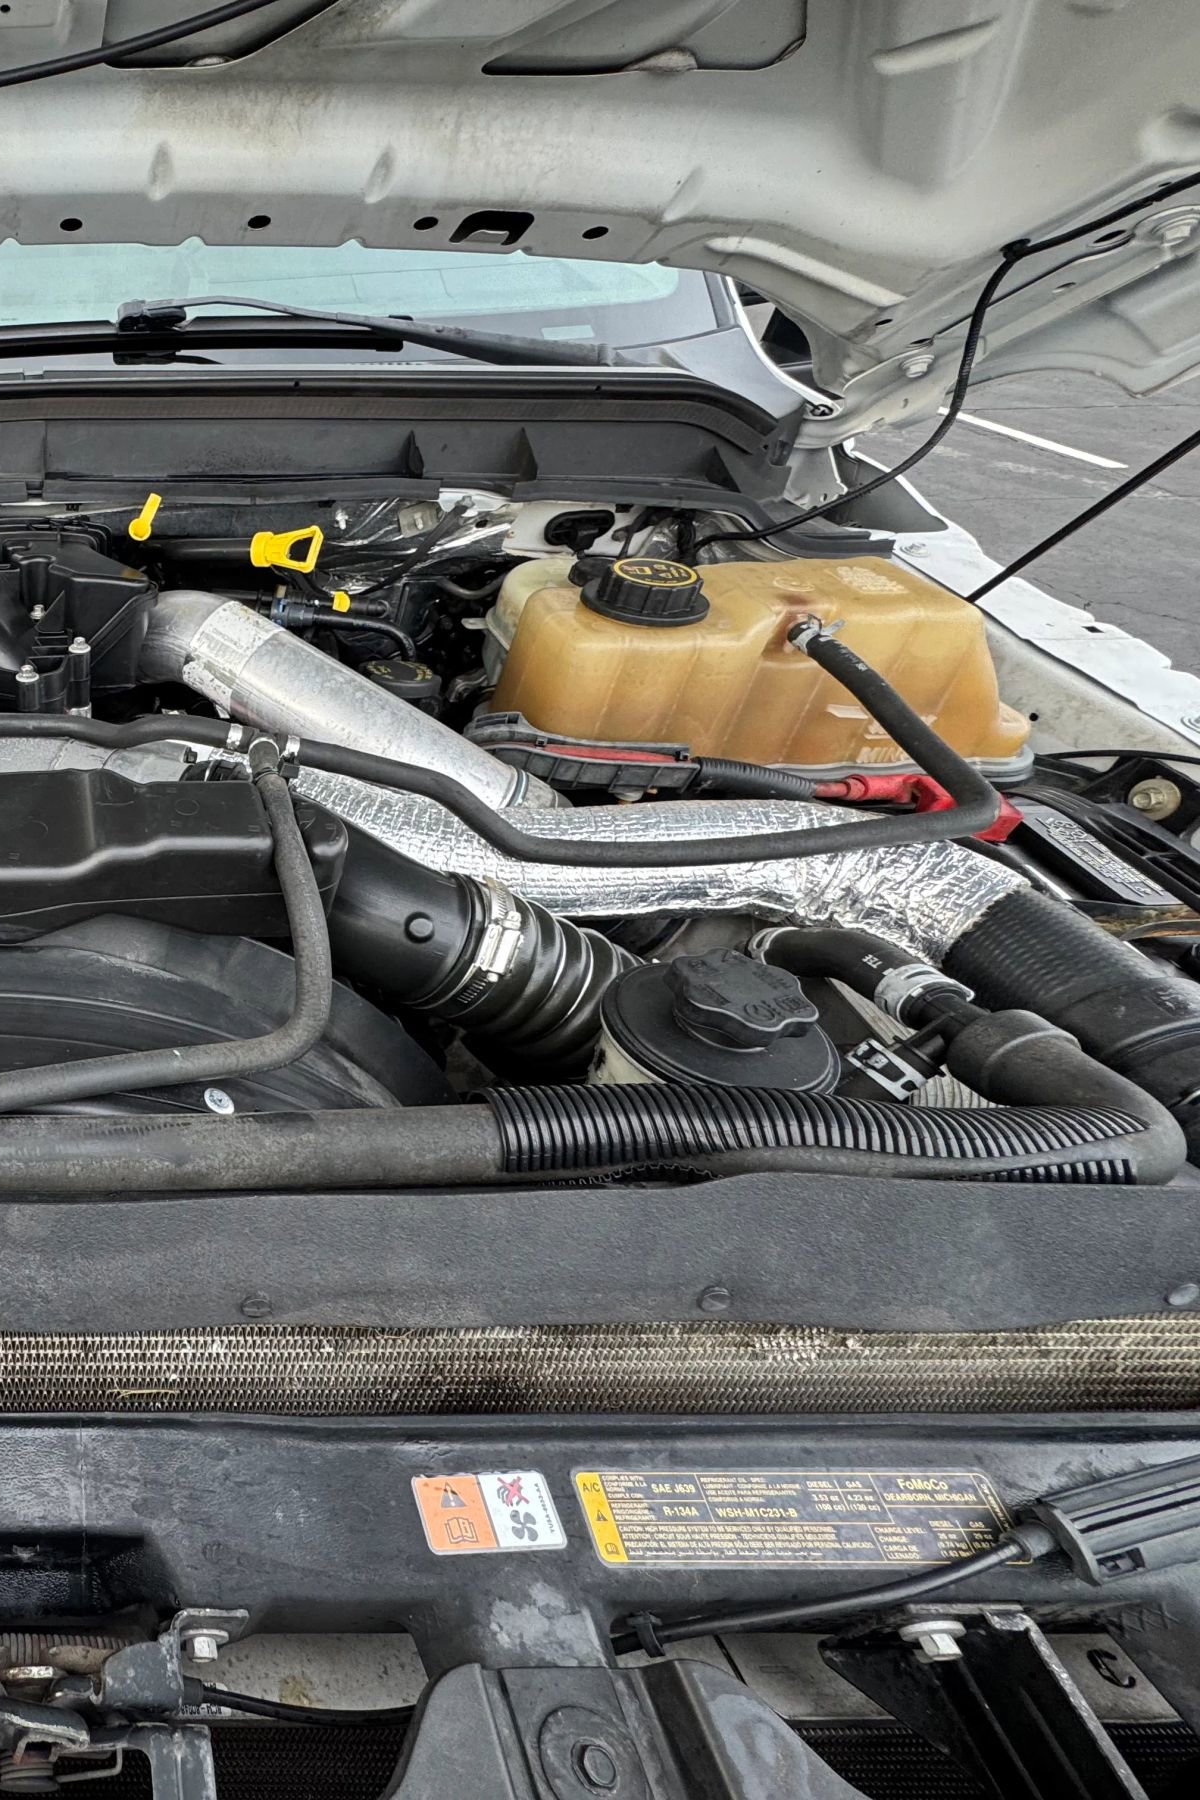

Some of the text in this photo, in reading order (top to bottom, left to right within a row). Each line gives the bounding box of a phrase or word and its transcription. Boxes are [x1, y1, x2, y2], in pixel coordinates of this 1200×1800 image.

[861, 954, 883, 969] TEE
[582, 1482, 601, 1493] A/C
[651, 1483, 674, 1494] SAE
[673, 1483, 697, 1494] J639
[806, 1480, 863, 1489] DIESEL GAS
[897, 1478, 949, 1490] FoMoCo
[934, 1493, 977, 1502] MICHIGAN
[662, 1506, 700, 1517] R-134A
[715, 1507, 799, 1519] WSH-M1C231-B
[969, 1521, 986, 1529] GAS
